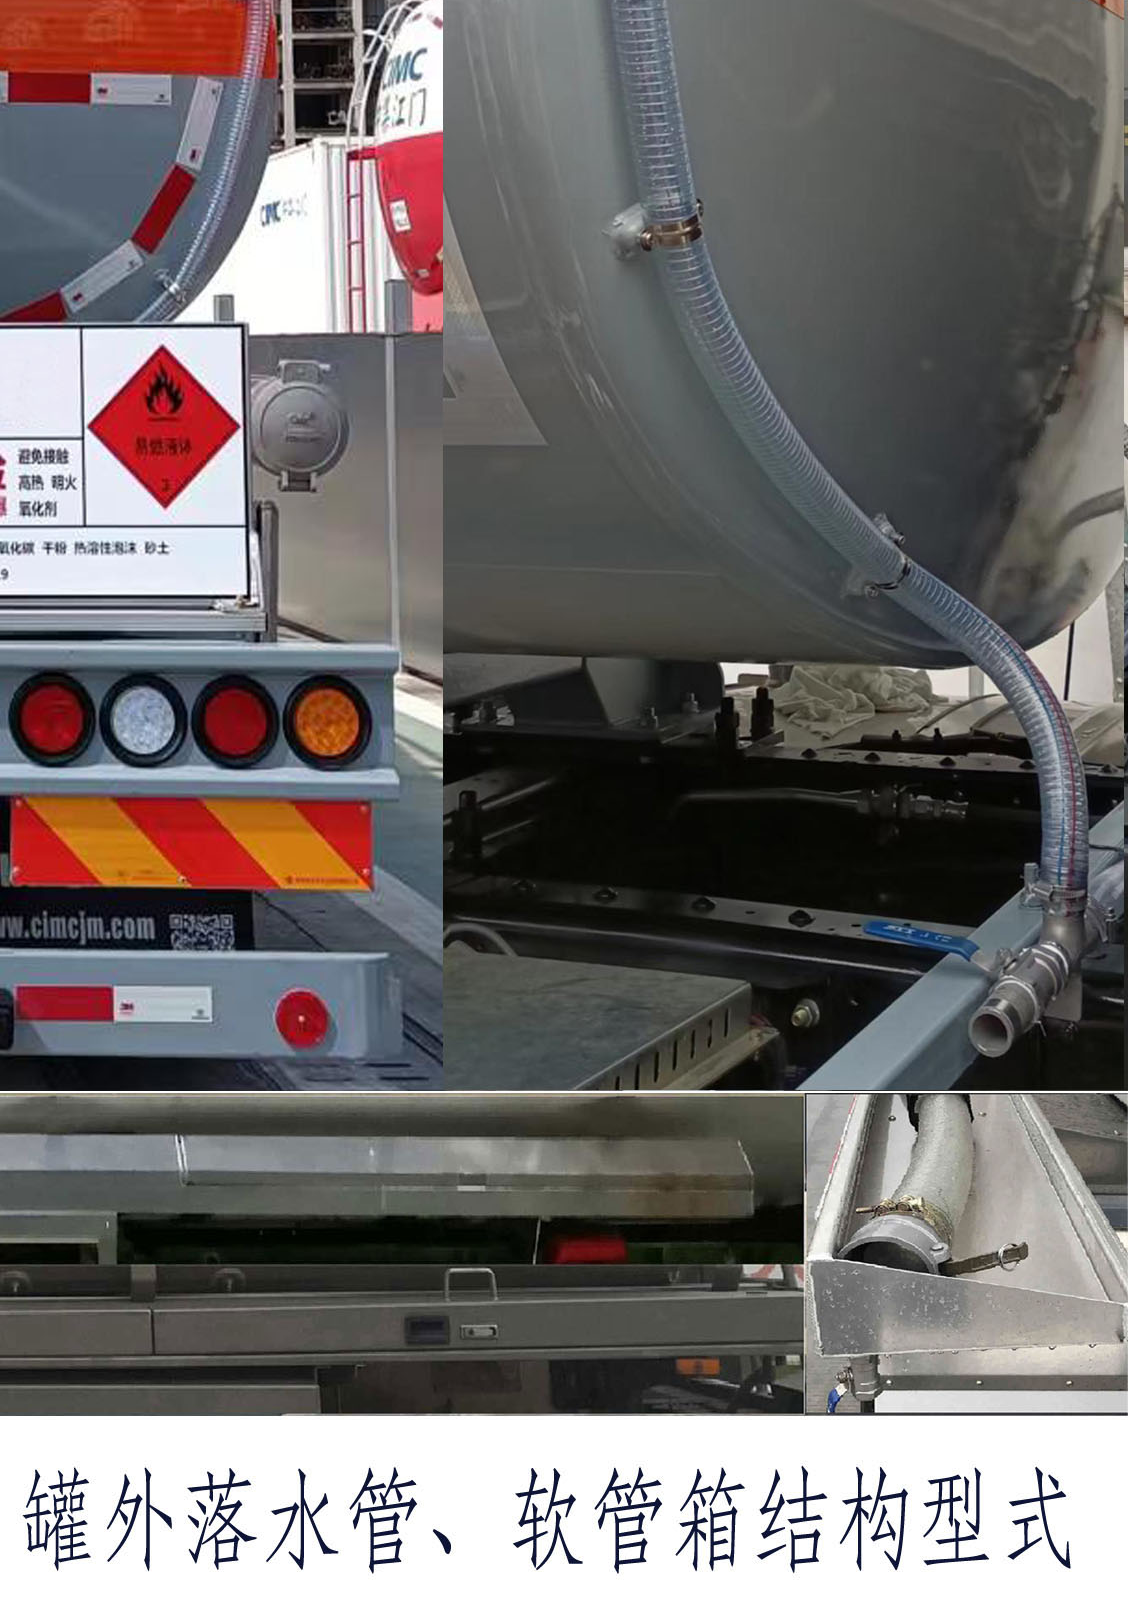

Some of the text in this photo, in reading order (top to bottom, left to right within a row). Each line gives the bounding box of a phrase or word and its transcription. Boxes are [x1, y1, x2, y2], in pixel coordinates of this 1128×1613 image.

[18, 448, 69, 465] 避免接触
[51, 473, 77, 491] 明火
[19, 500, 57, 517] 氧化剂
[42, 541, 67, 556] 干粉
